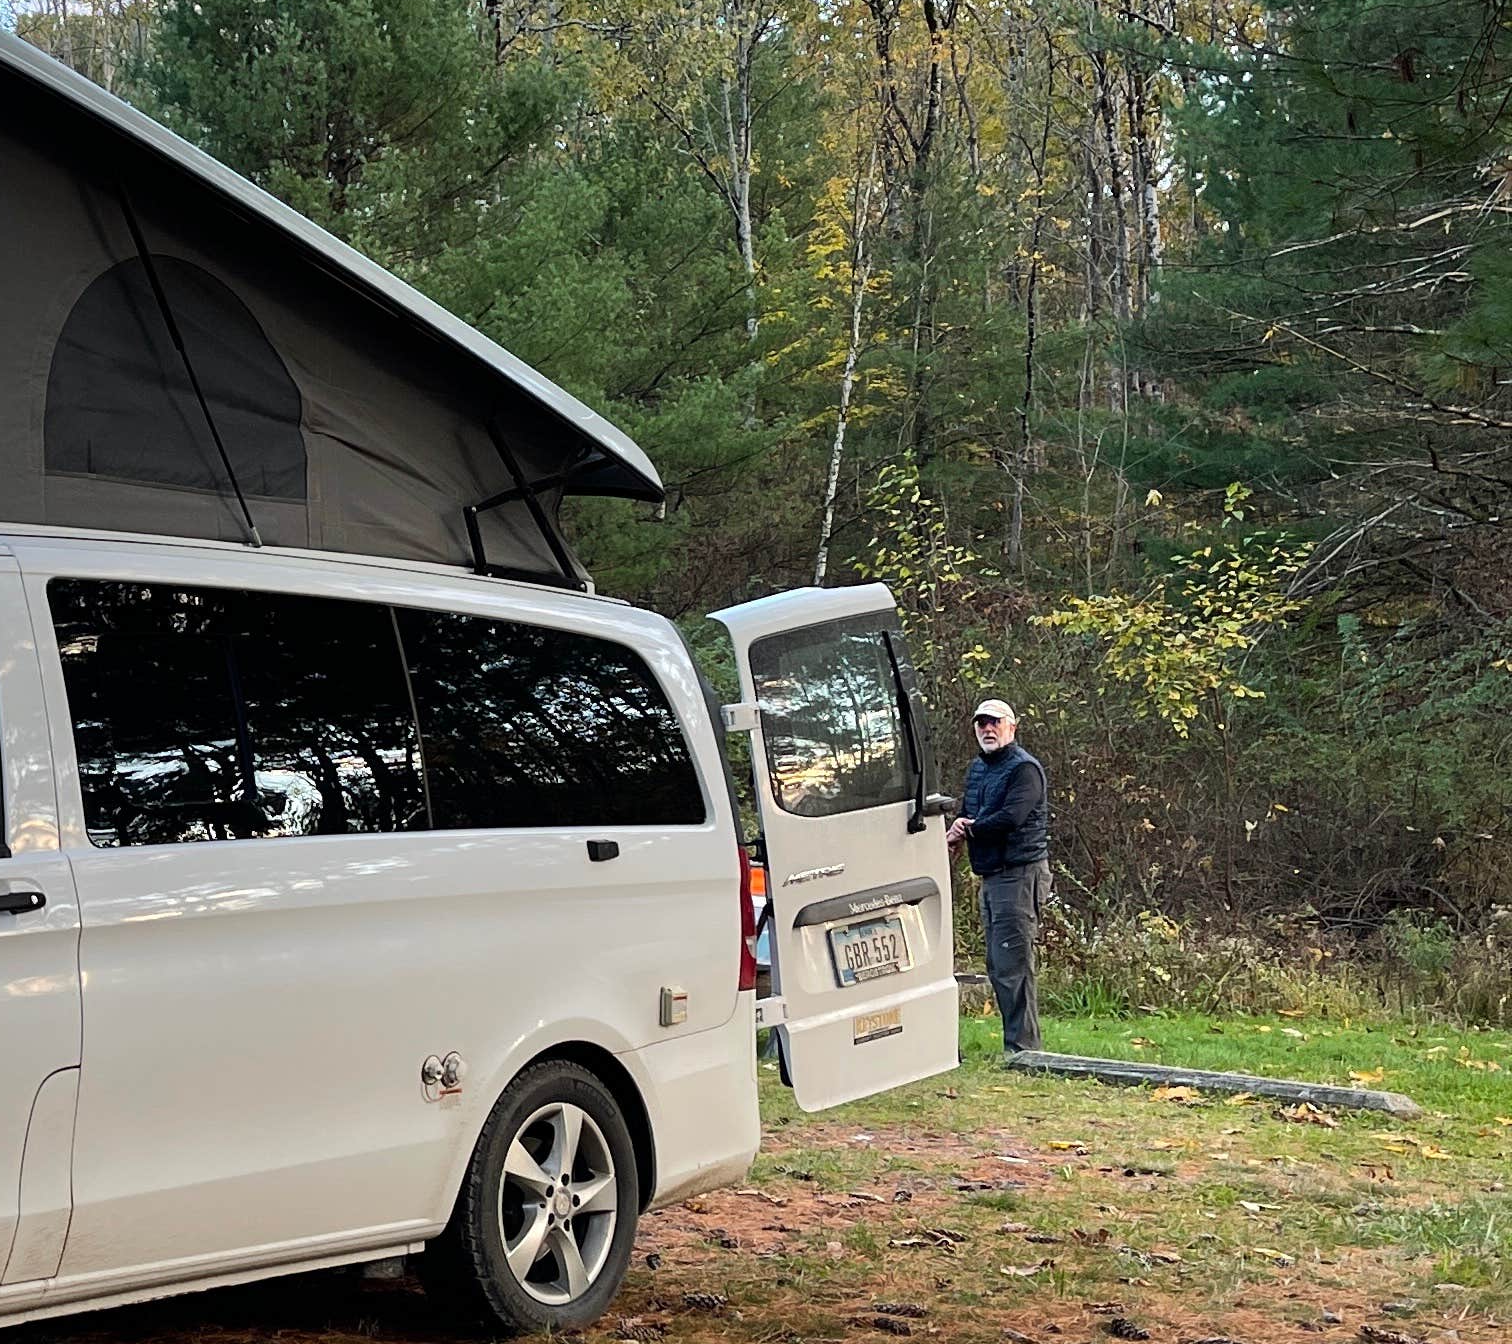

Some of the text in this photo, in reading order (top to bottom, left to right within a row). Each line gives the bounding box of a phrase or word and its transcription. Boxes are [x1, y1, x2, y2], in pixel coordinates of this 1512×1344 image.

[849, 893, 904, 914] Mercedes-Benz
[845, 934, 899, 970] GBR 552
